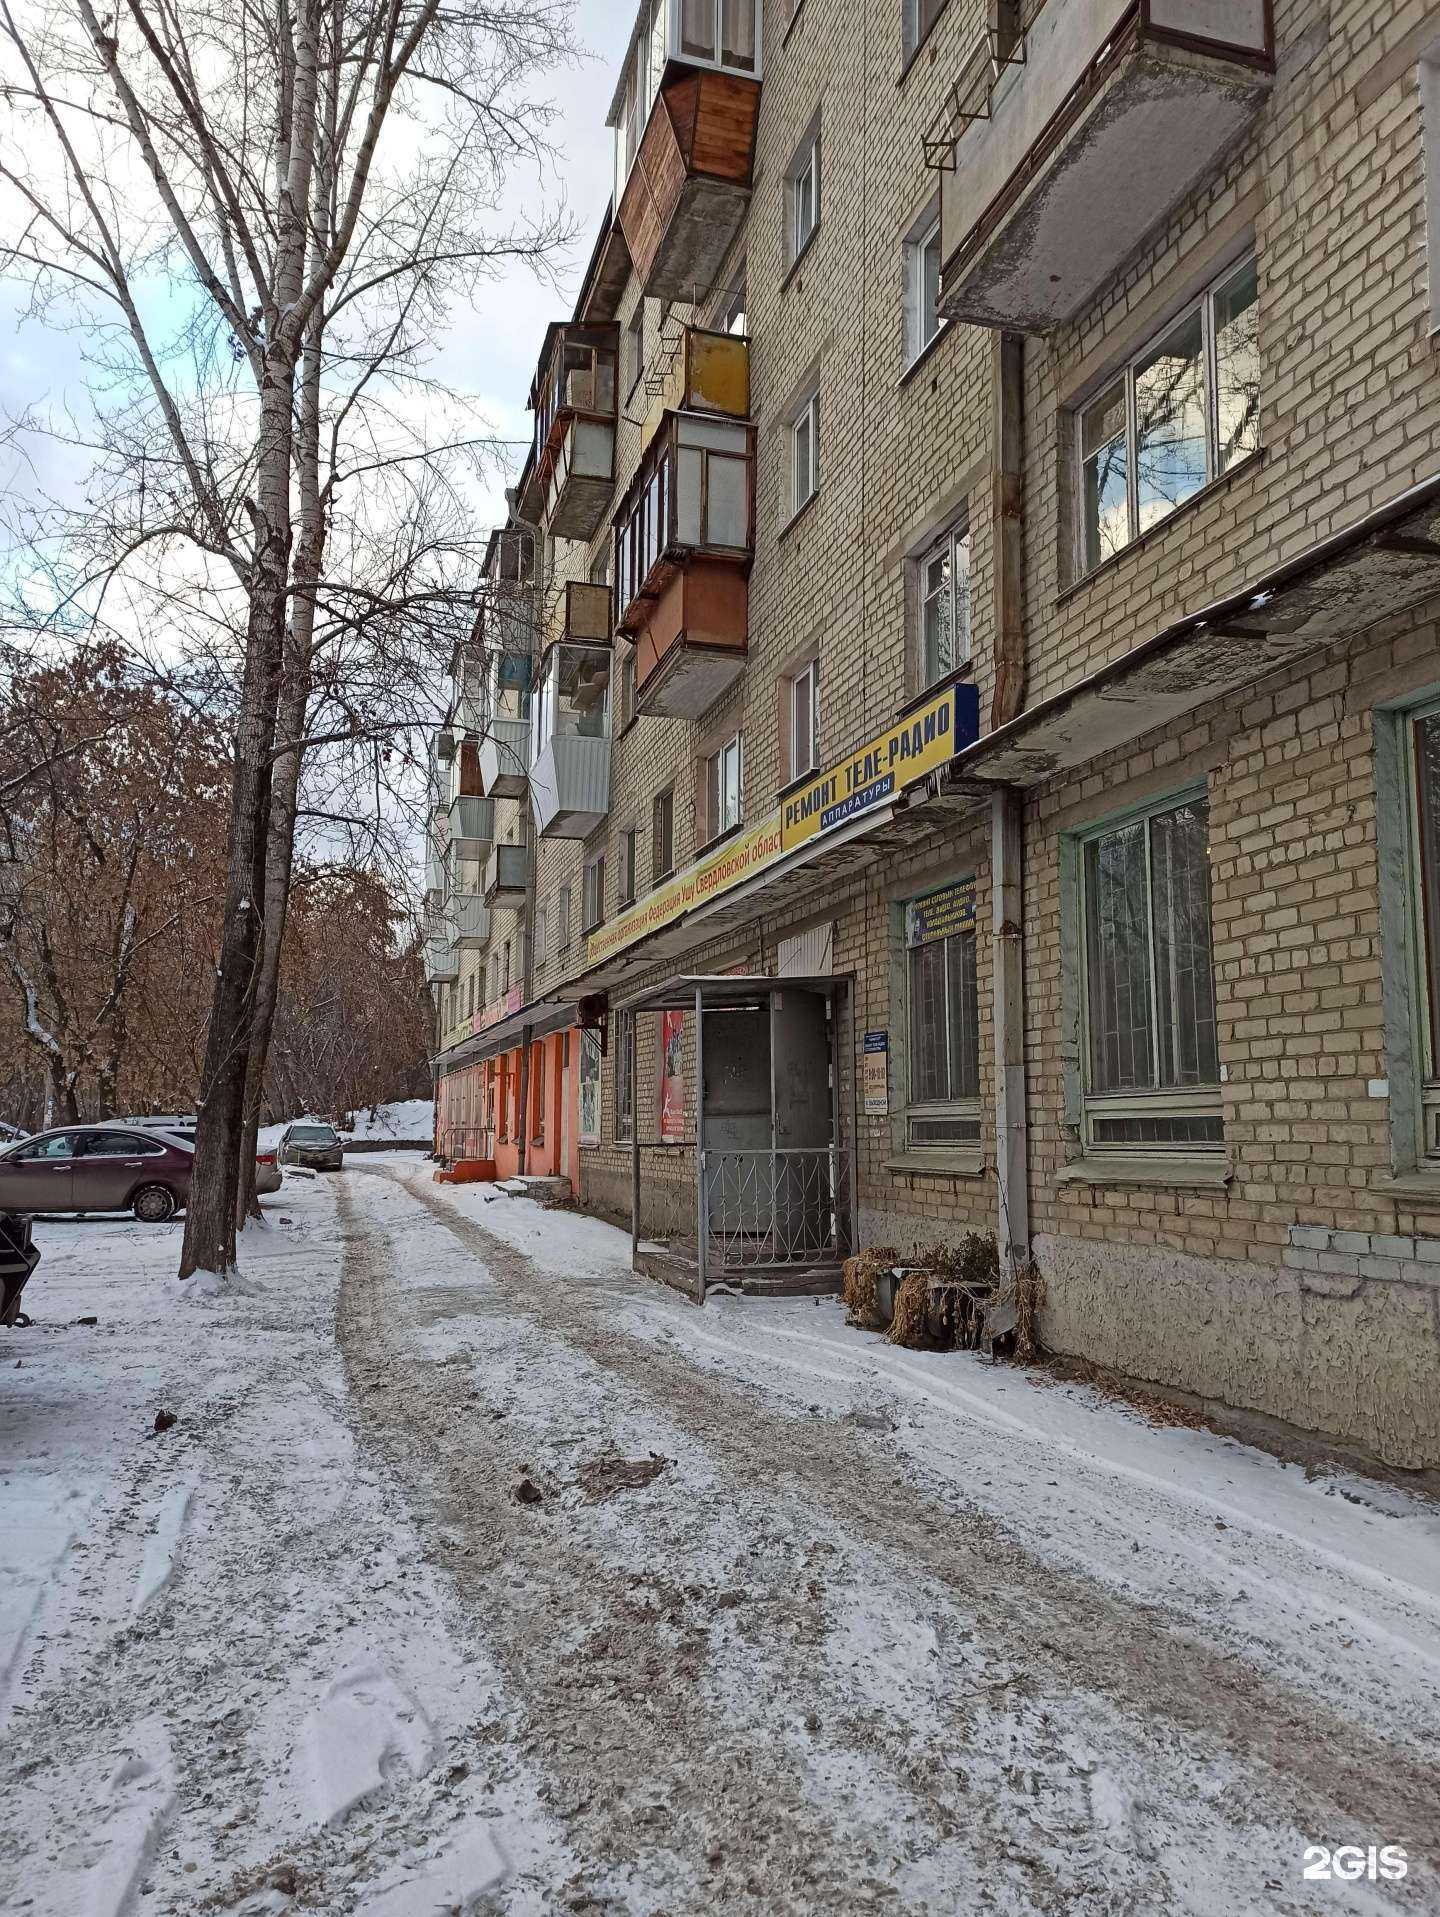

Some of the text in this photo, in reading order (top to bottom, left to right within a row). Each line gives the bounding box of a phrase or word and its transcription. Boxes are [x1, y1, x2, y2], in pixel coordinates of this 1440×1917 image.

[786, 702, 949, 829] РЕМОНТ ТЕЛЕ-РАДИО
[822, 778, 891, 826] АППАРАТУРЫ
[648, 891, 680, 922] Федерация
[681, 883, 695, 903] Ушу
[696, 843, 750, 894] Свердловской
